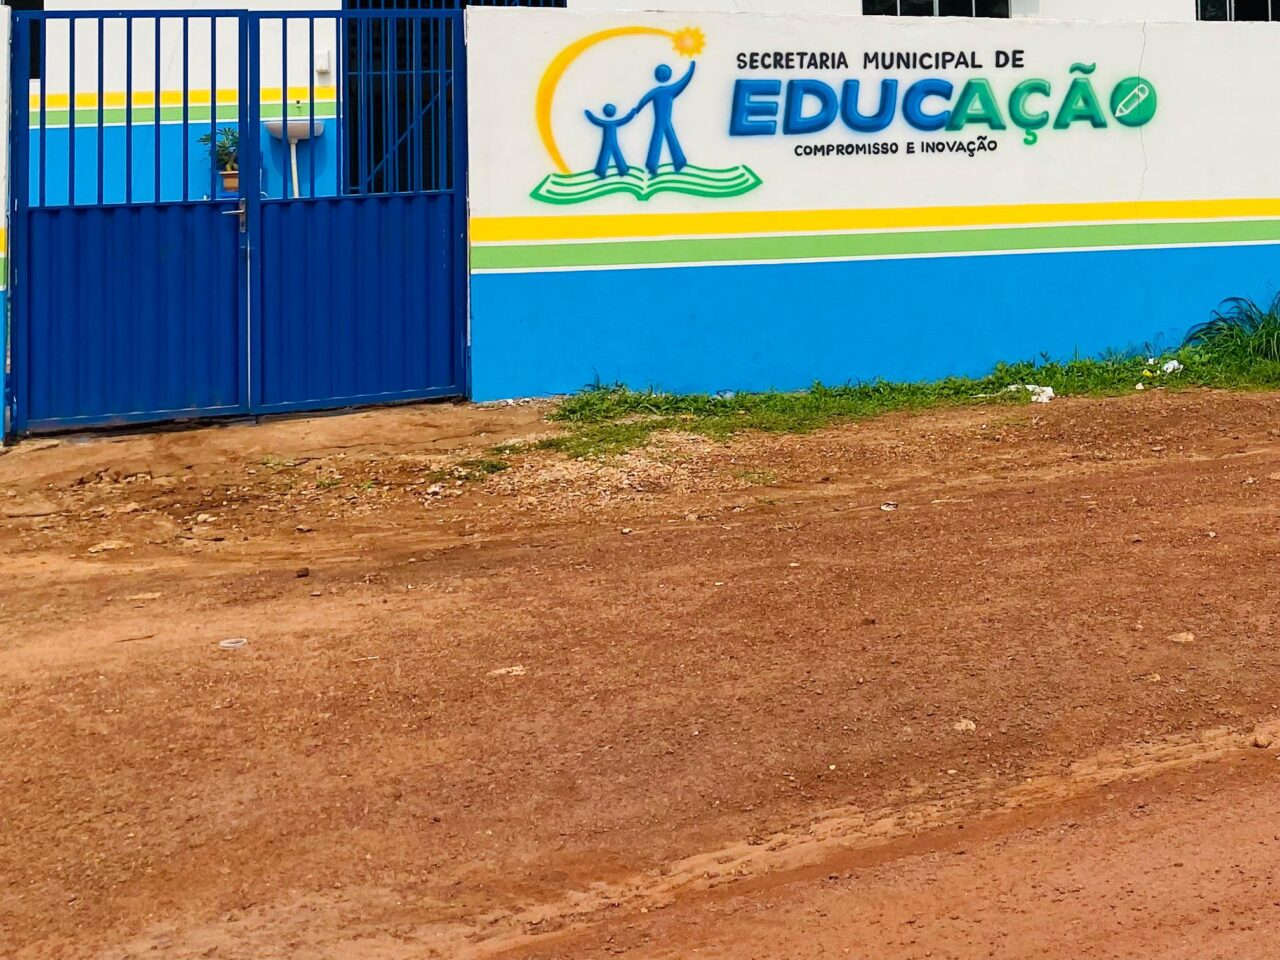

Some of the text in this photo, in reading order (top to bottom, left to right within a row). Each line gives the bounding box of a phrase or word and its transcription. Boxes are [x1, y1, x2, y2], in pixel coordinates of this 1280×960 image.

[736, 49, 1025, 70] SECRETARIA MUNICIPAL DE
[728, 61, 1158, 146] EDUCAÇÃO
[793, 135, 998, 158] COMPROMISSO E INOVAÇÃO
